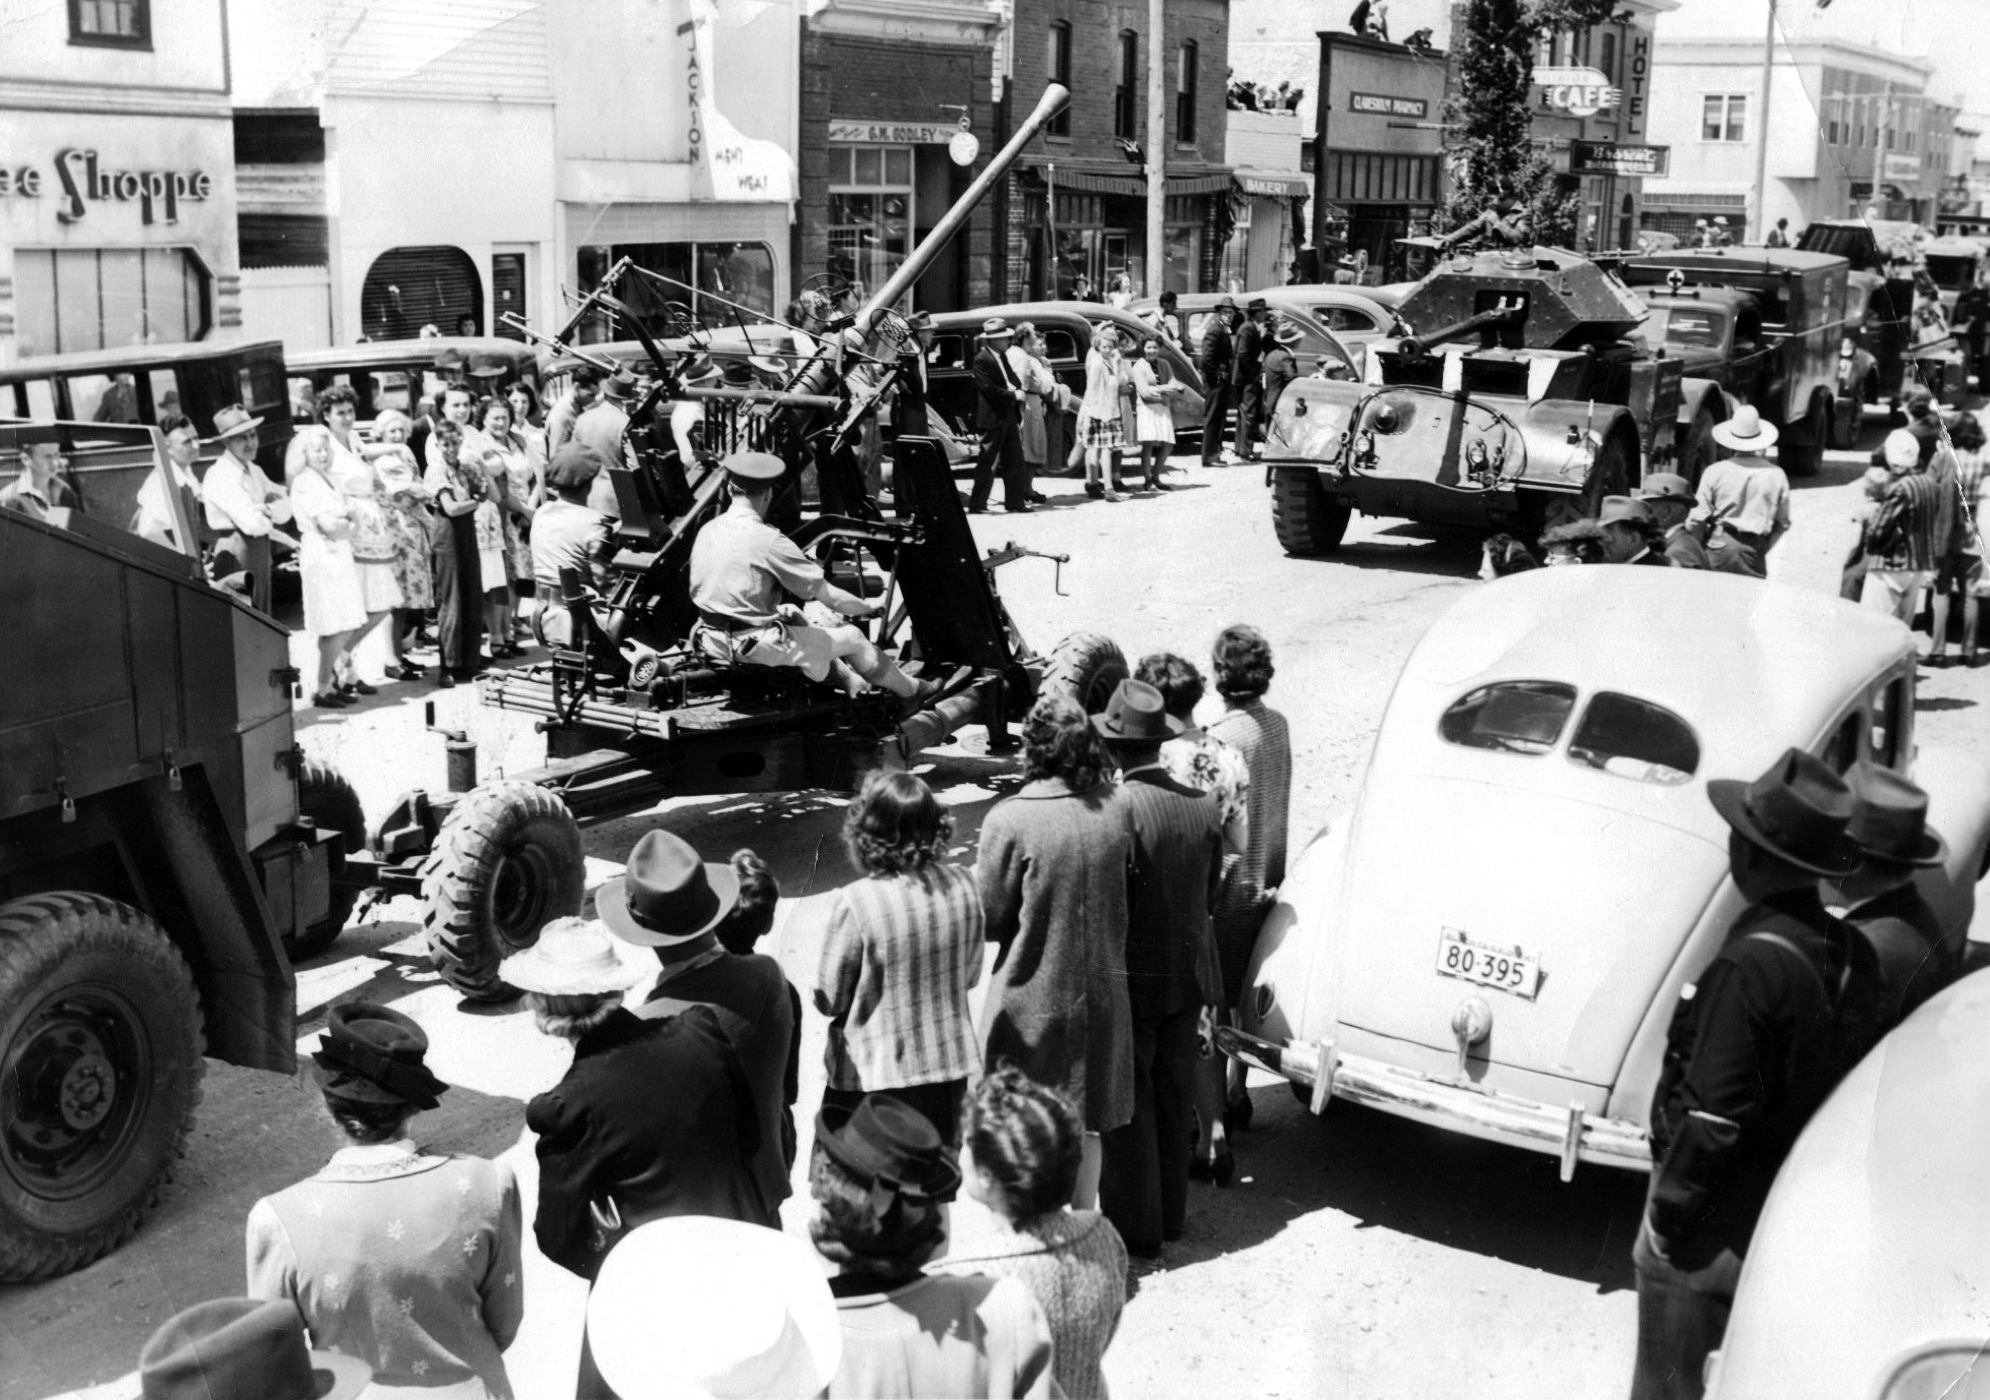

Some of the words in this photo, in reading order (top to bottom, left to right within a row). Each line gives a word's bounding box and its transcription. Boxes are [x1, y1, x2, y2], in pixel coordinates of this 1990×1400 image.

[1553, 85, 1612, 108] CAFE
[1628, 37, 1647, 134] HOTEL
[893, 127, 937, 142] GODLEY
[54, 149, 211, 225] Shoppe
[1246, 179, 1288, 194] BAKERY
